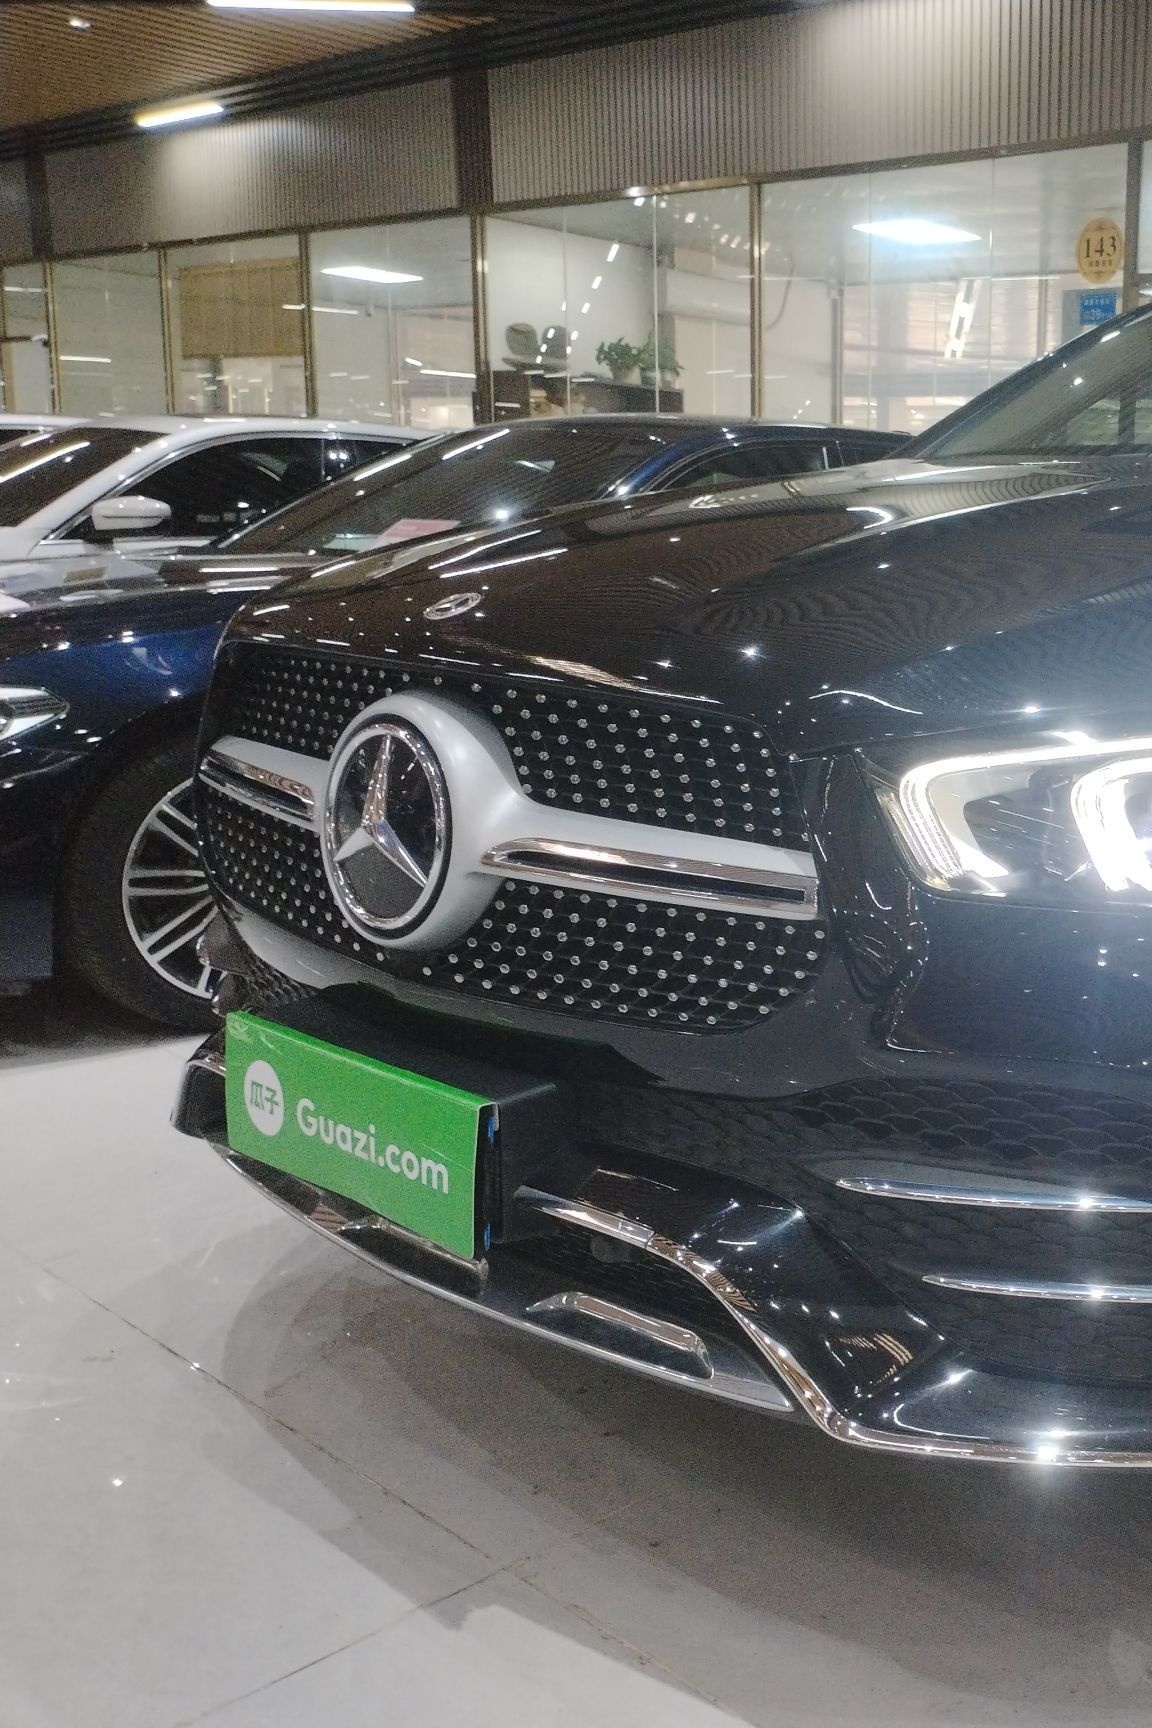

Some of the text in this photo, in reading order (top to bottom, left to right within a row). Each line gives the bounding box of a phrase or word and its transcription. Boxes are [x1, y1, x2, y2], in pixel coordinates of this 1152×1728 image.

[1084, 236, 1117, 258] 143
[250, 1081, 280, 1115] 瓜子
[297, 1098, 449, 1194] Guazi.com
